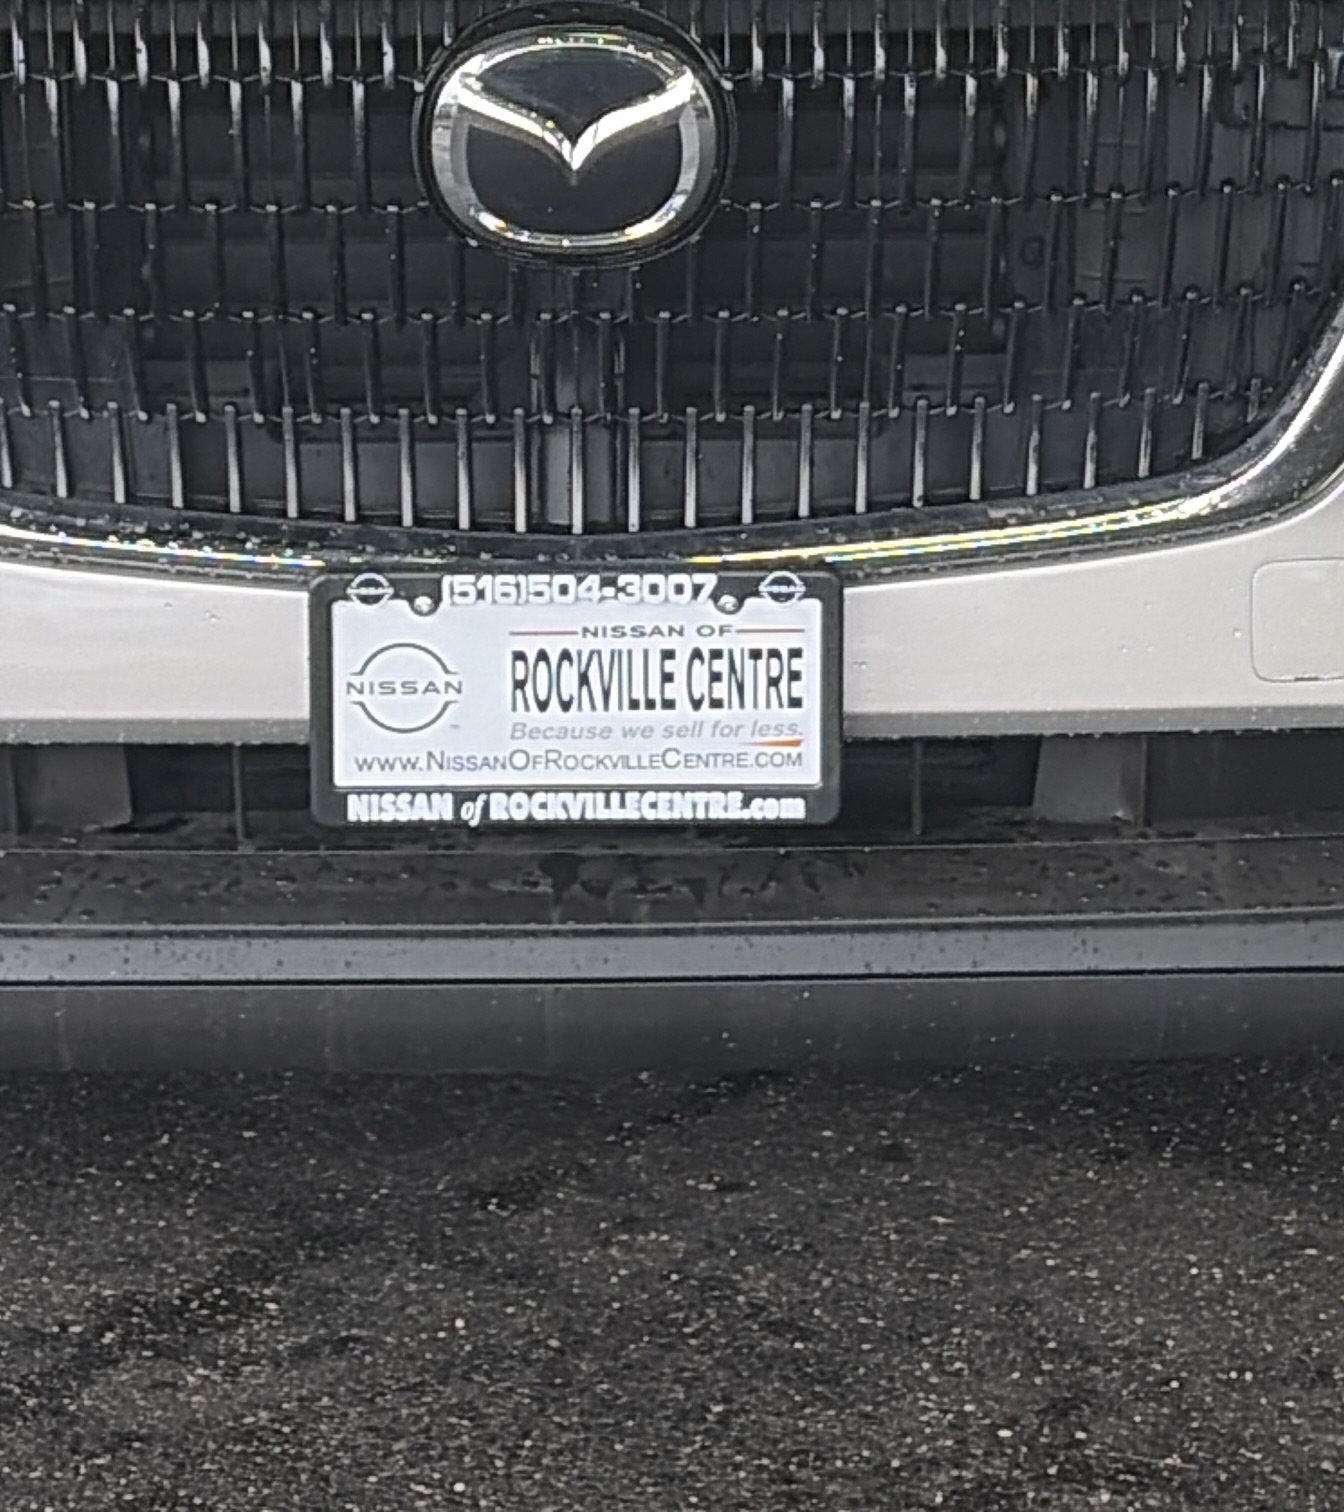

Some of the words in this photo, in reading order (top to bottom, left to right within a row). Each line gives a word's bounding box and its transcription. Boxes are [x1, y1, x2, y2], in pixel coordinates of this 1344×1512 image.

[441, 574, 717, 605] (516)504-3007
[581, 625, 684, 638] NISSAN
[696, 625, 733, 637] OF
[346, 681, 463, 695] NISSAN
[511, 648, 677, 712] ROCKVILLE
[686, 647, 803, 711] CENTRE
[510, 722, 613, 740] Because
[621, 725, 654, 739] we
[662, 721, 704, 739] sell
[710, 721, 743, 739] for
[750, 719, 804, 738] less.
[347, 792, 454, 822] NISSAN
[460, 793, 488, 827] of
[489, 791, 806, 821] ROCKVILLECENTRE.com
